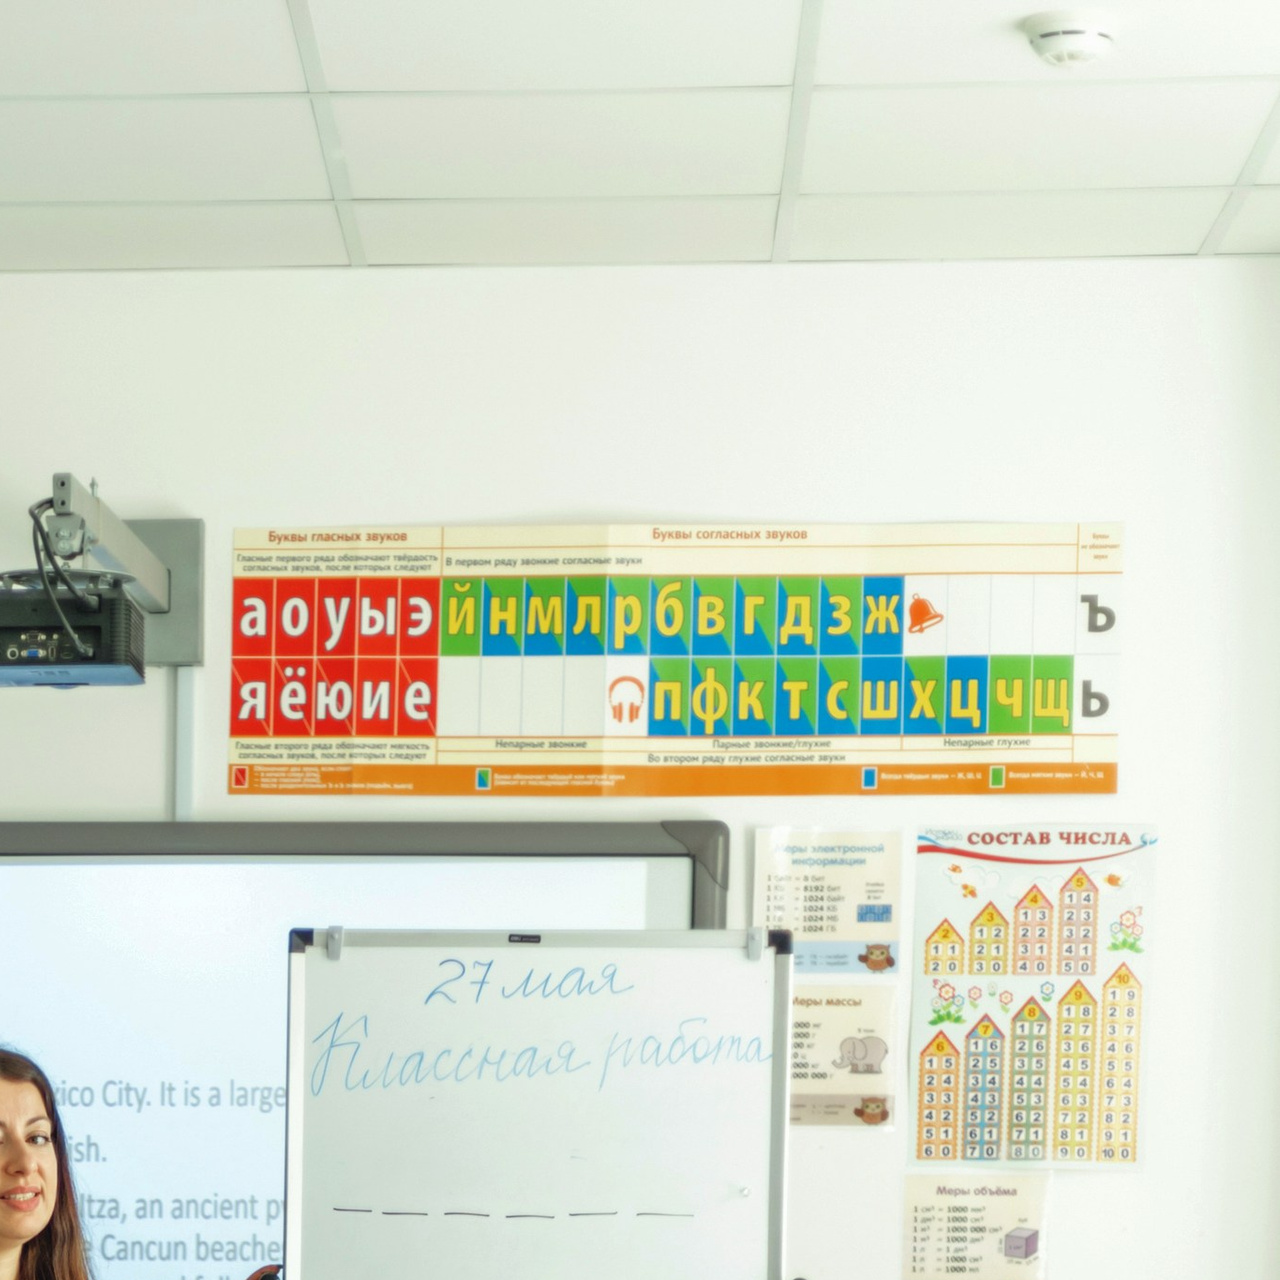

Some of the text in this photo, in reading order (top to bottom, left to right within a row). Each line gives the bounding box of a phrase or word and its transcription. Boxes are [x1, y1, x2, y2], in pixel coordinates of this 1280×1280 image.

[269, 531, 407, 544] Буквы гласных звуков
[653, 528, 807, 542] Буквы согласных звуков
[237, 554, 272, 562] Гласные
[314, 555, 335, 563] ряда
[446, 557, 642, 568] В первом ряду звонкие согласные звуки
[448, 581, 899, 648] й н м л р б в г д з ж
[240, 597, 432, 651] а о у ы э
[239, 667, 431, 720] я ё ю и е
[654, 668, 1070, 736] п ф к т с ш х ц ч щ
[495, 740, 545, 750] Непарные
[713, 740, 750, 749] Парные
[944, 738, 1030, 748] Непарные глухие
[648, 754, 845, 764] Во втором ряду глухие согласные звуки
[967, 832, 1051, 845] СОСТАВ
[1059, 832, 1132, 845] ЧИСЛА
[1030, 894, 1038, 904] 4
[1023, 911, 1046, 920] 1 3
[1022, 928, 1045, 937] 2 2
[1021, 945, 1044, 954] 3 1
[1019, 962, 1044, 971] 4 0
[425, 959, 634, 1004] 27 мая
[311, 1011, 773, 1096] Классная работа
[102, 1080, 151, 1113] City.
[161, 1081, 176, 1106] It
[184, 1081, 200, 1106] is
[209, 1087, 220, 1106] a
[230, 1079, 286, 1113] large
[937, 1186, 1017, 1196] Меры объёма
[135, 1198, 163, 1219] an
[171, 1193, 258, 1219] ancient
[101, 1234, 186, 1262] Cancun
